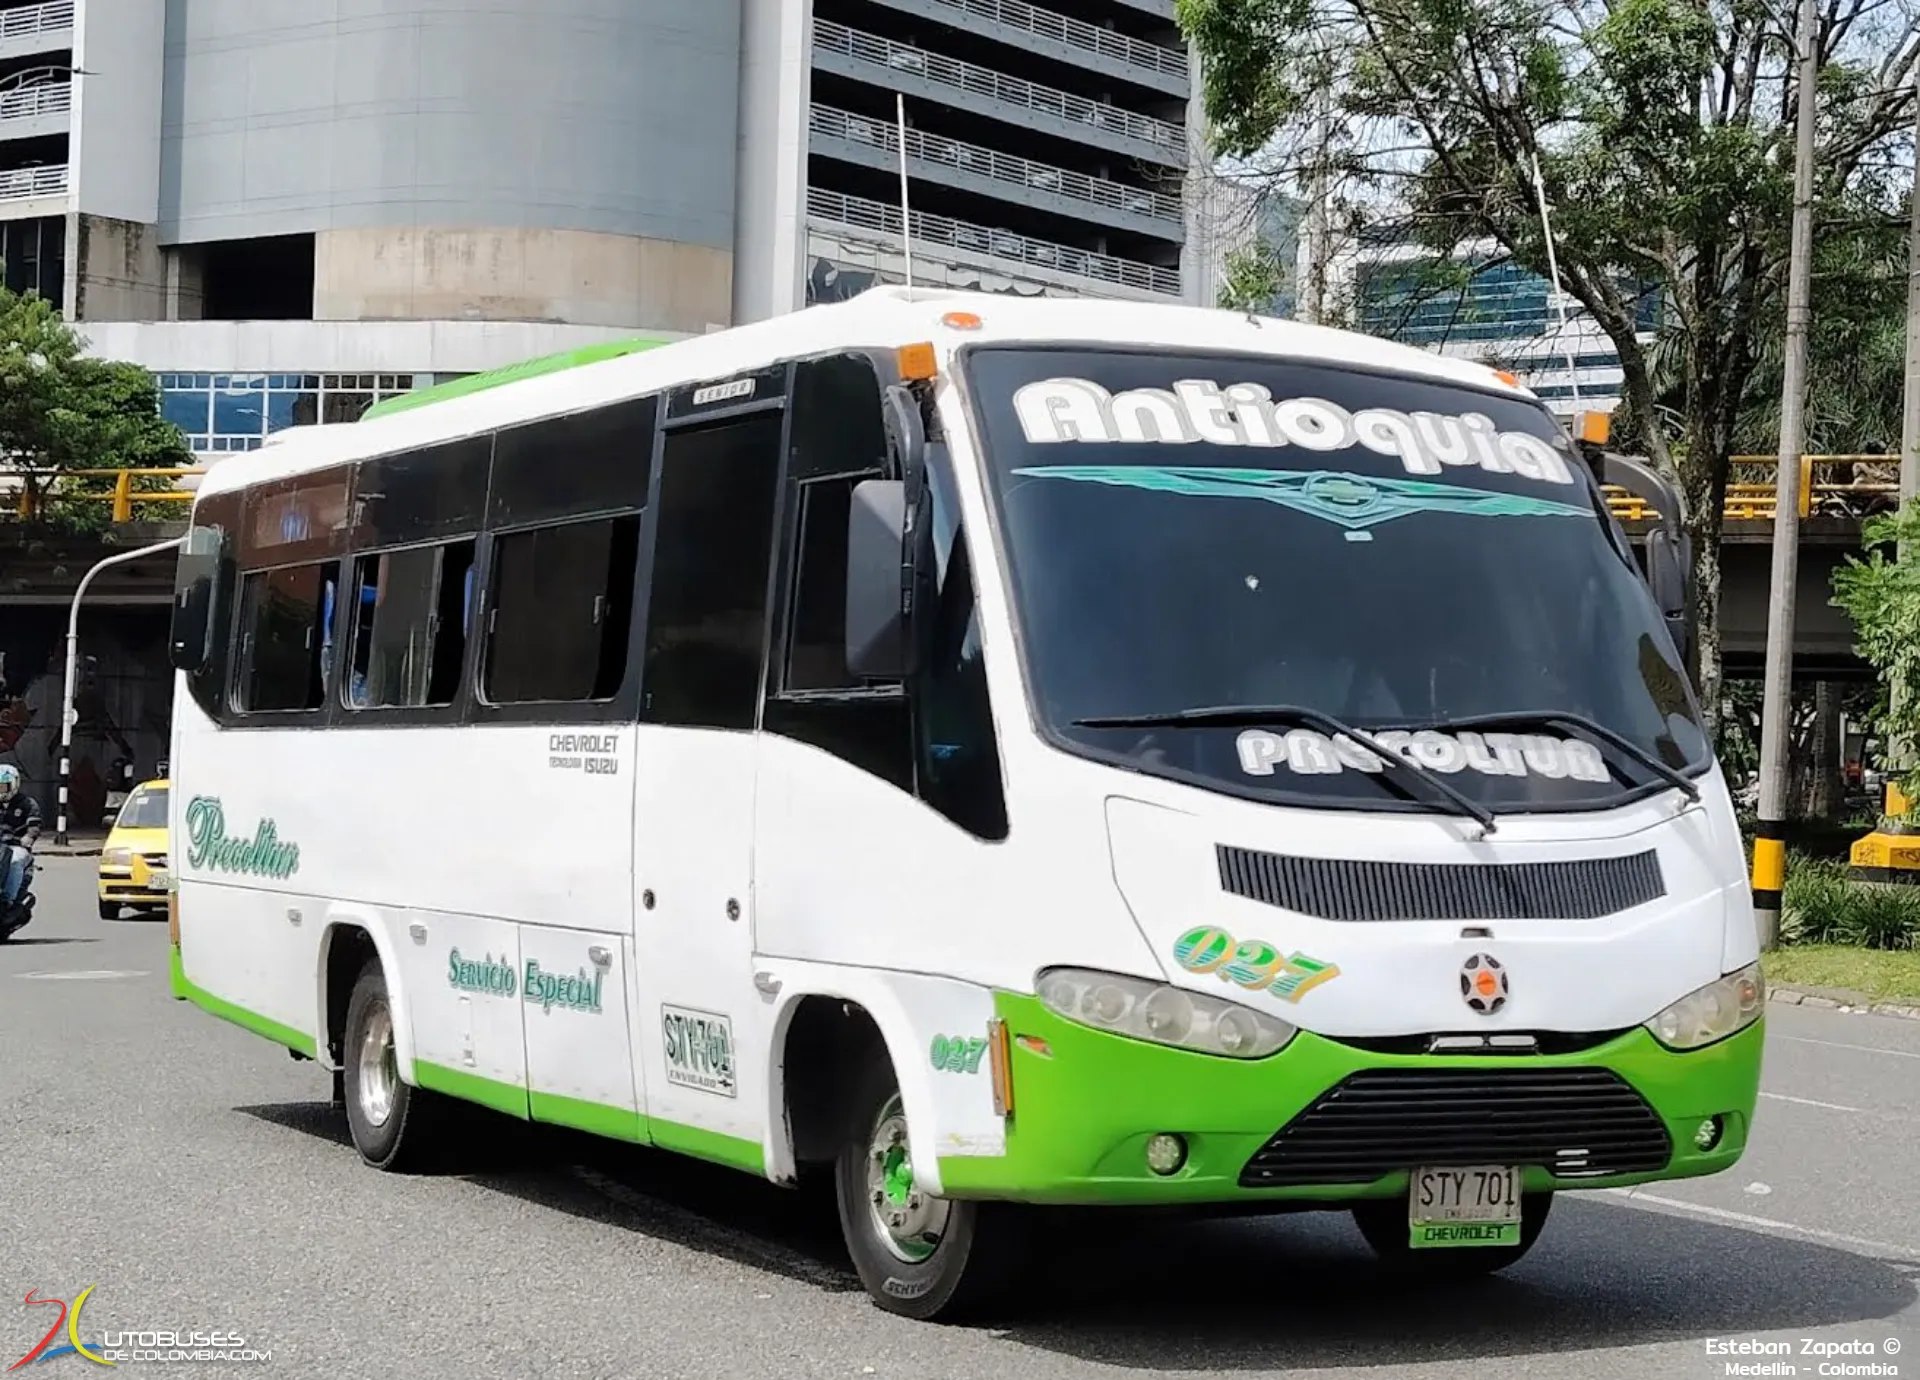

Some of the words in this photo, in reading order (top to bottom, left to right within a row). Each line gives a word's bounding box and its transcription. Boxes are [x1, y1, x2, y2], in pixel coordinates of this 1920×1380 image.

[1012, 377, 1574, 484] Antioquia
[549, 734, 620, 753] CHEVROLET
[584, 757, 619, 775] ISUZU
[1173, 925, 1342, 1005] 027
[930, 1033, 988, 1075] 027
[1421, 1172, 1466, 1206] STY
[1474, 1171, 1515, 1206] 701
[1424, 1225, 1505, 1241] CHEVROLET
